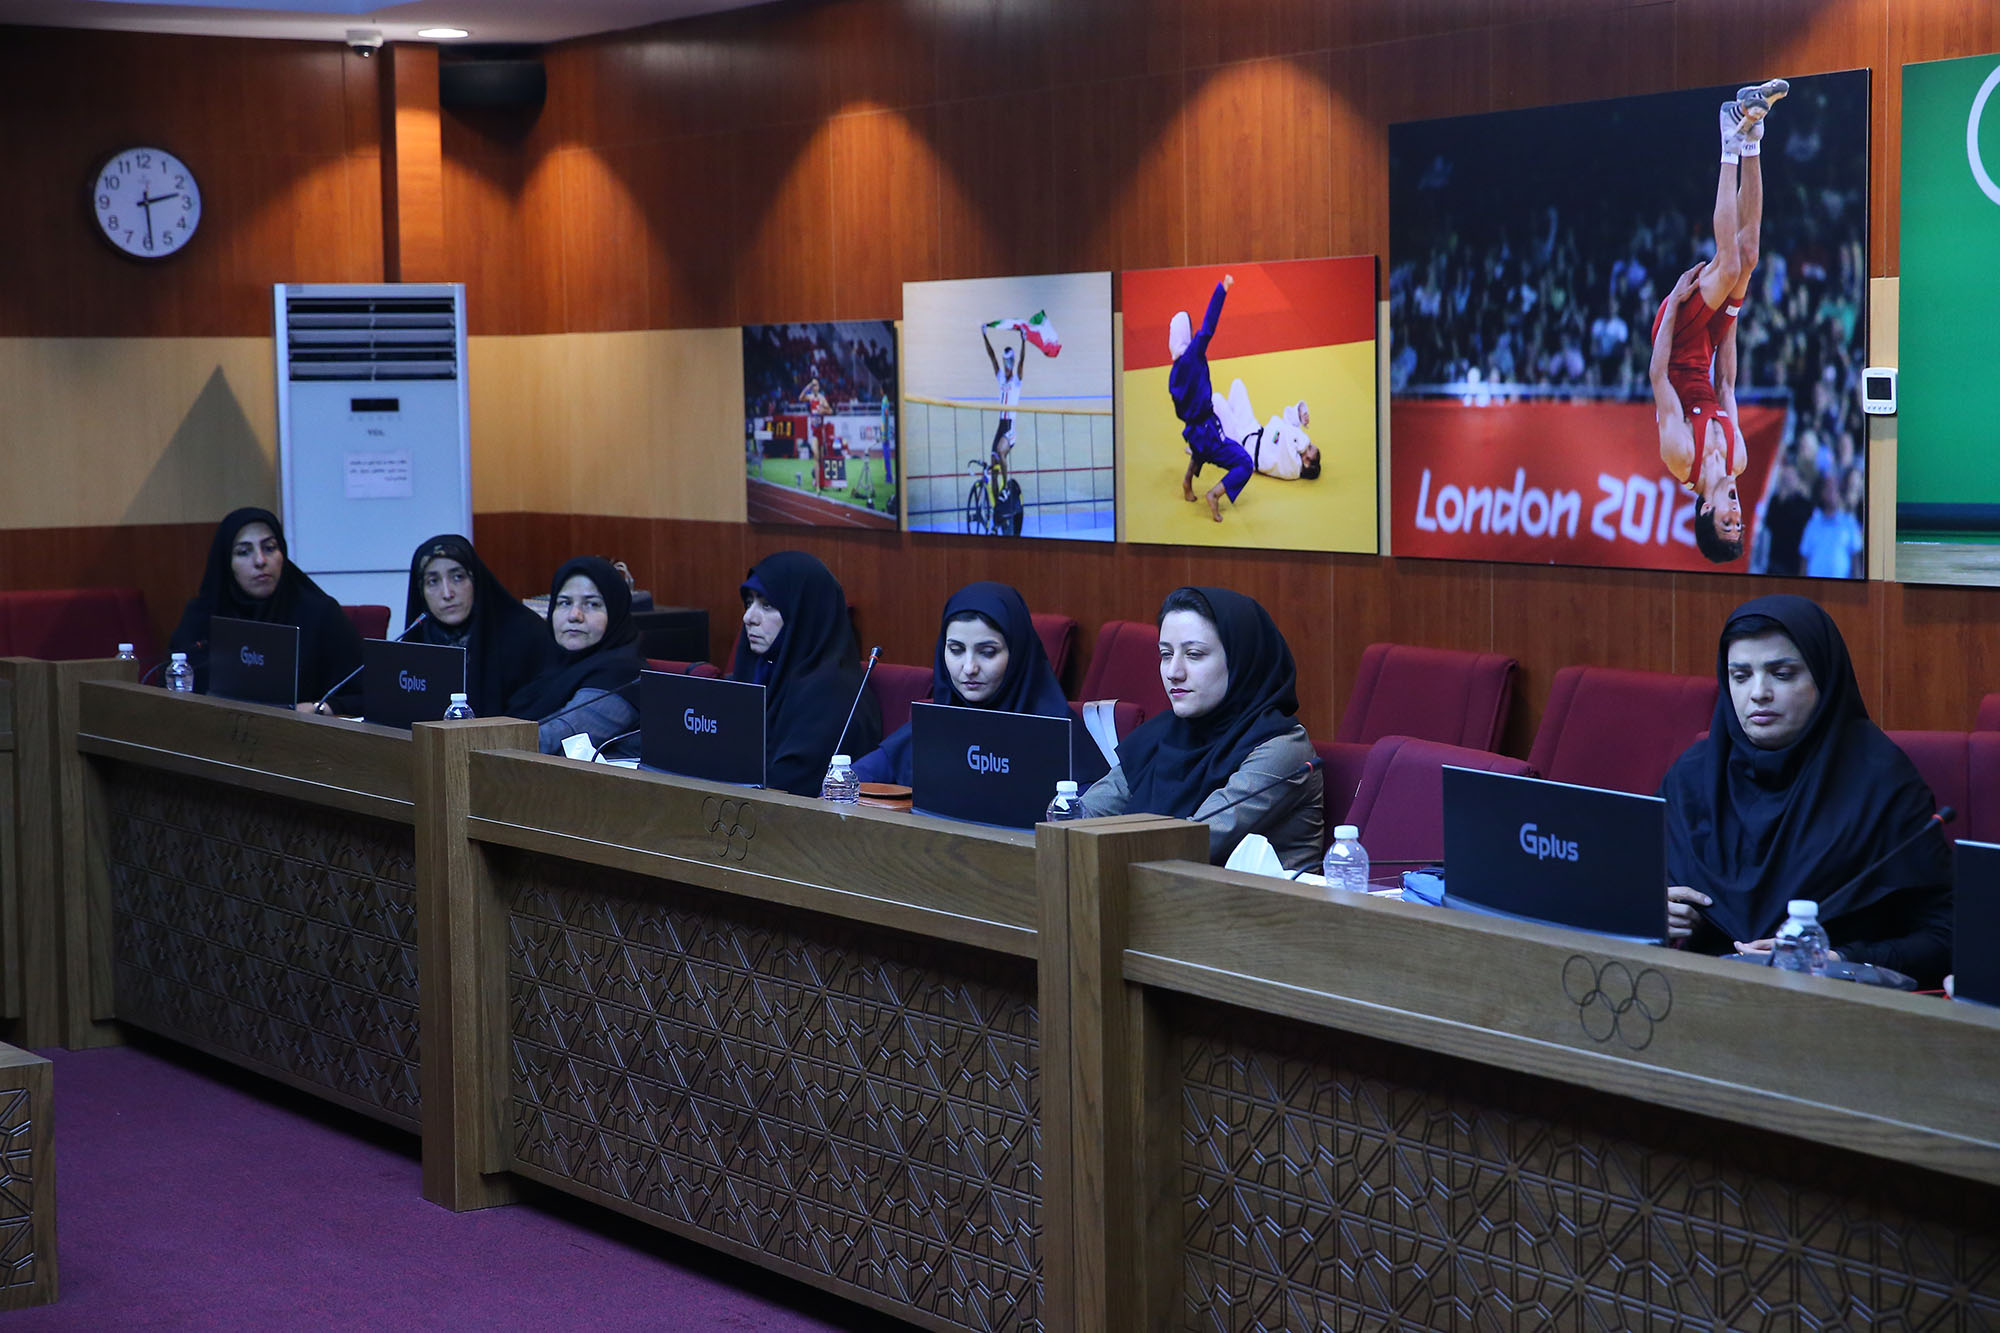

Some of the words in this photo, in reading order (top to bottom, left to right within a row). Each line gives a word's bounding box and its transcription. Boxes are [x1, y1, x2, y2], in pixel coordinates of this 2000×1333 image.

[119, 161, 131, 174] 11
[136, 153, 152, 169] 12
[161, 161, 167, 174] 1
[104, 175, 120, 190] 10
[175, 175, 185, 190] 2
[98, 195, 110, 210] 9
[182, 195, 193, 211] 3
[108, 215, 119, 231] 8
[176, 216, 187, 230] 4
[124, 230, 134, 244] 7
[143, 234, 153, 251] 6
[163, 231, 173, 246] 5
[1415, 467, 1582, 539] London
[399, 670, 427, 693] Gplus
[683, 708, 718, 734] Gplus
[967, 744, 1010, 775] Gplus
[1520, 822, 1579, 862] Gplus
